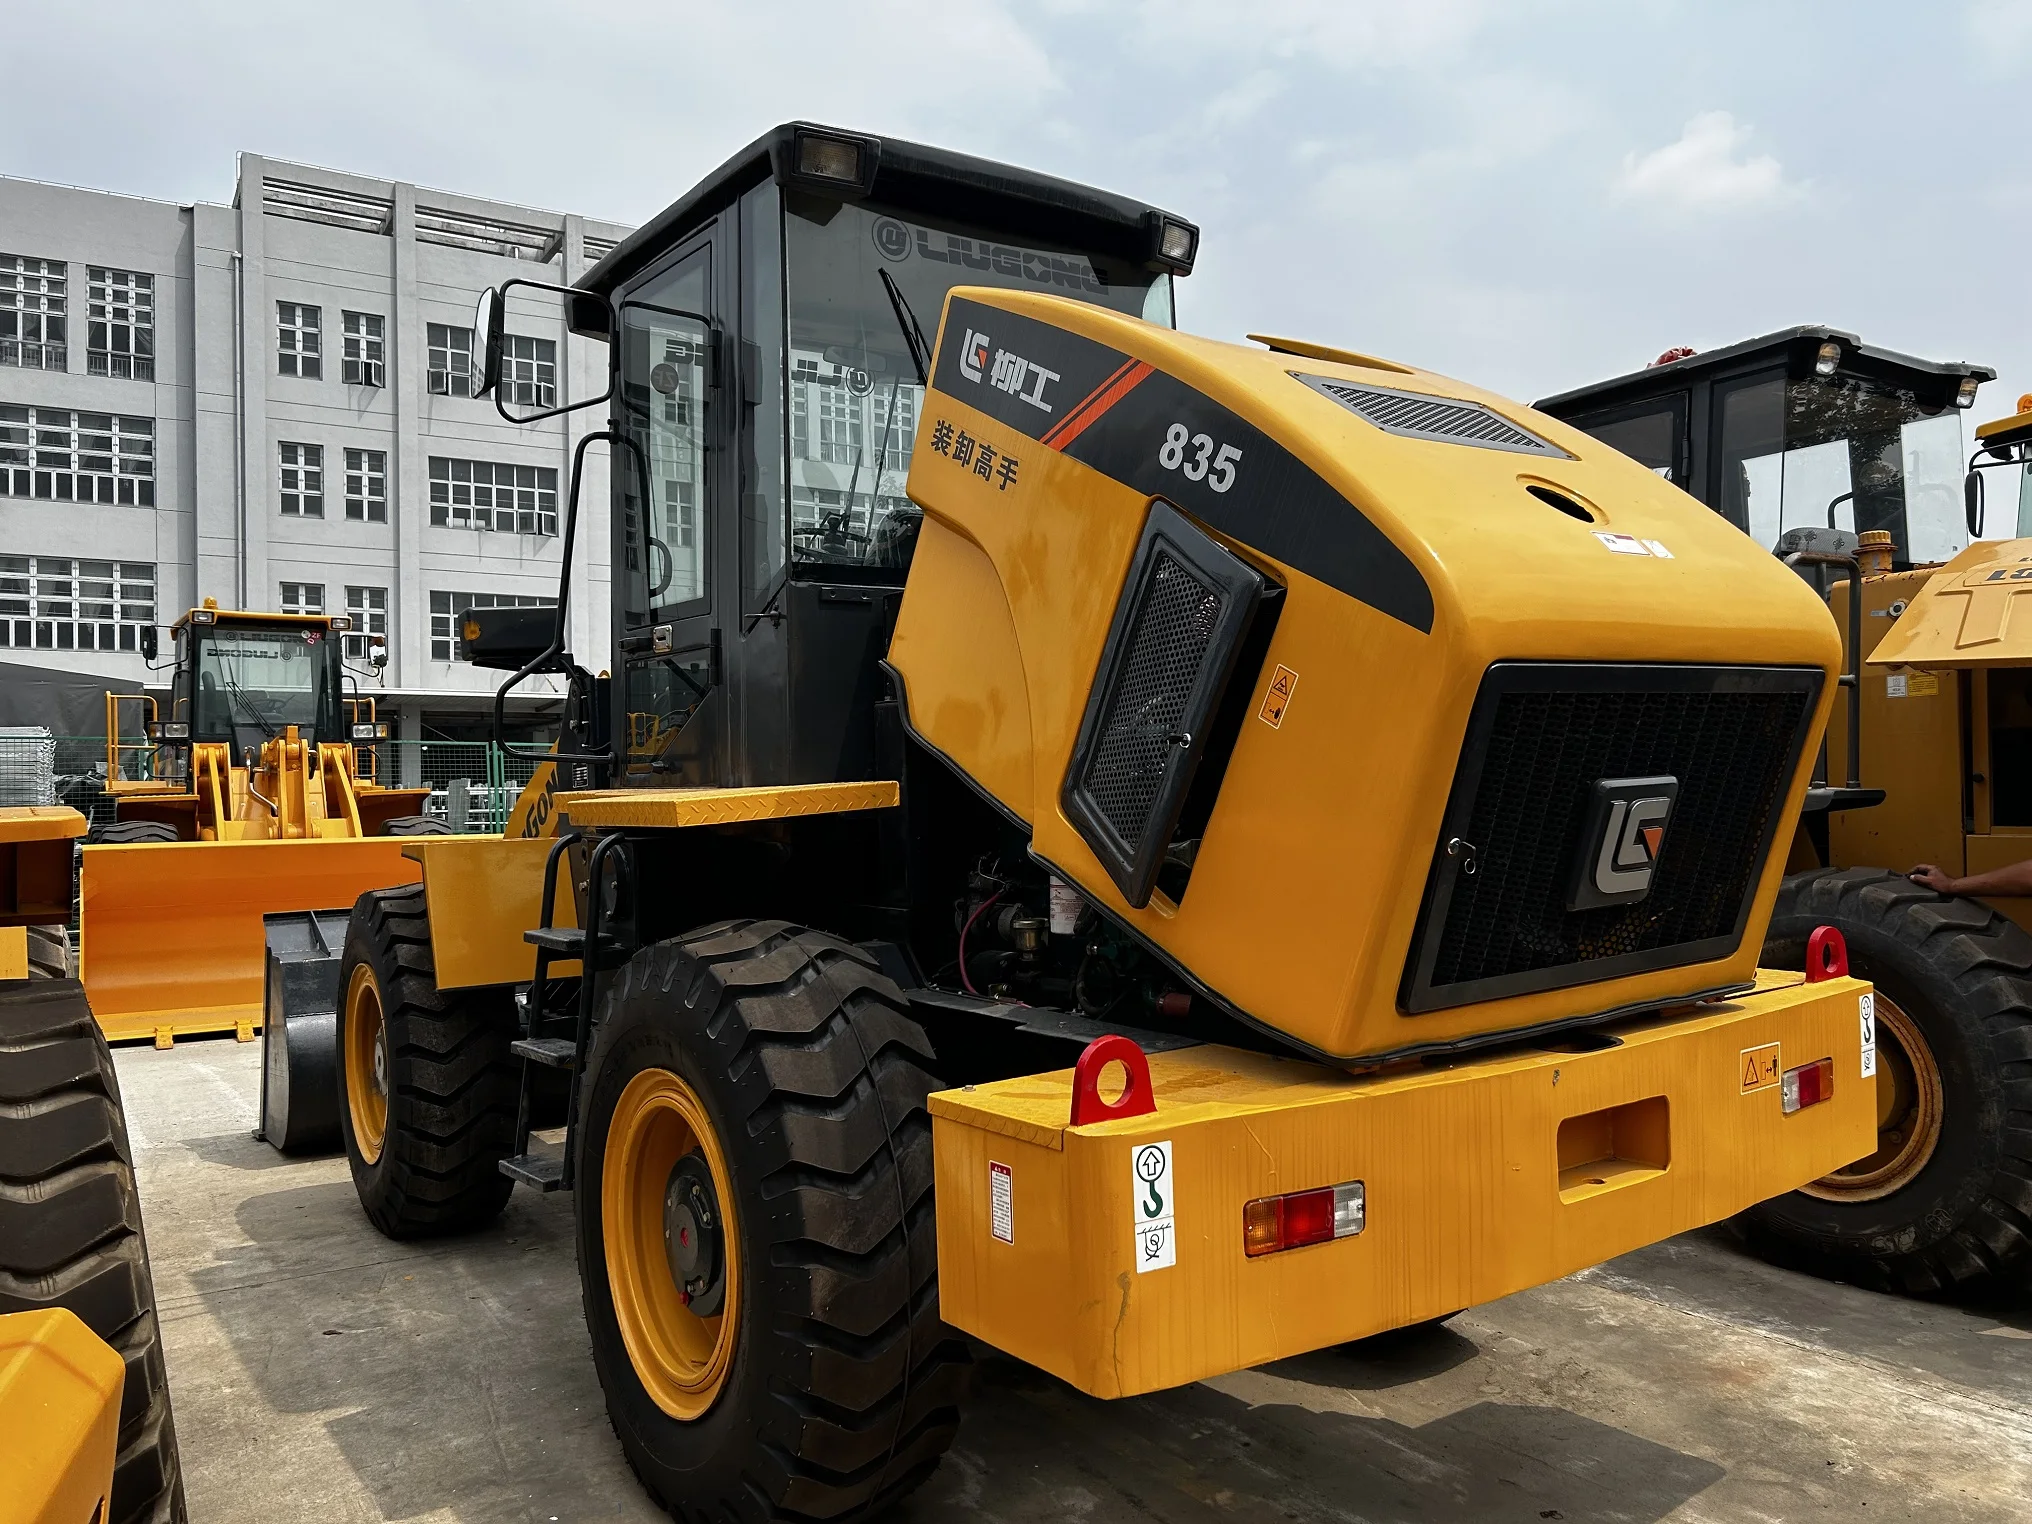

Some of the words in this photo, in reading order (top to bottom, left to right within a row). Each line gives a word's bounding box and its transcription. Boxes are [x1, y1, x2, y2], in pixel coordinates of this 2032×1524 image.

[916, 228, 1110, 296] LIUGONG
[990, 348, 1061, 414] 柳工
[930, 419, 1019, 491] 装卸高手
[1159, 423, 1243, 493] 835
